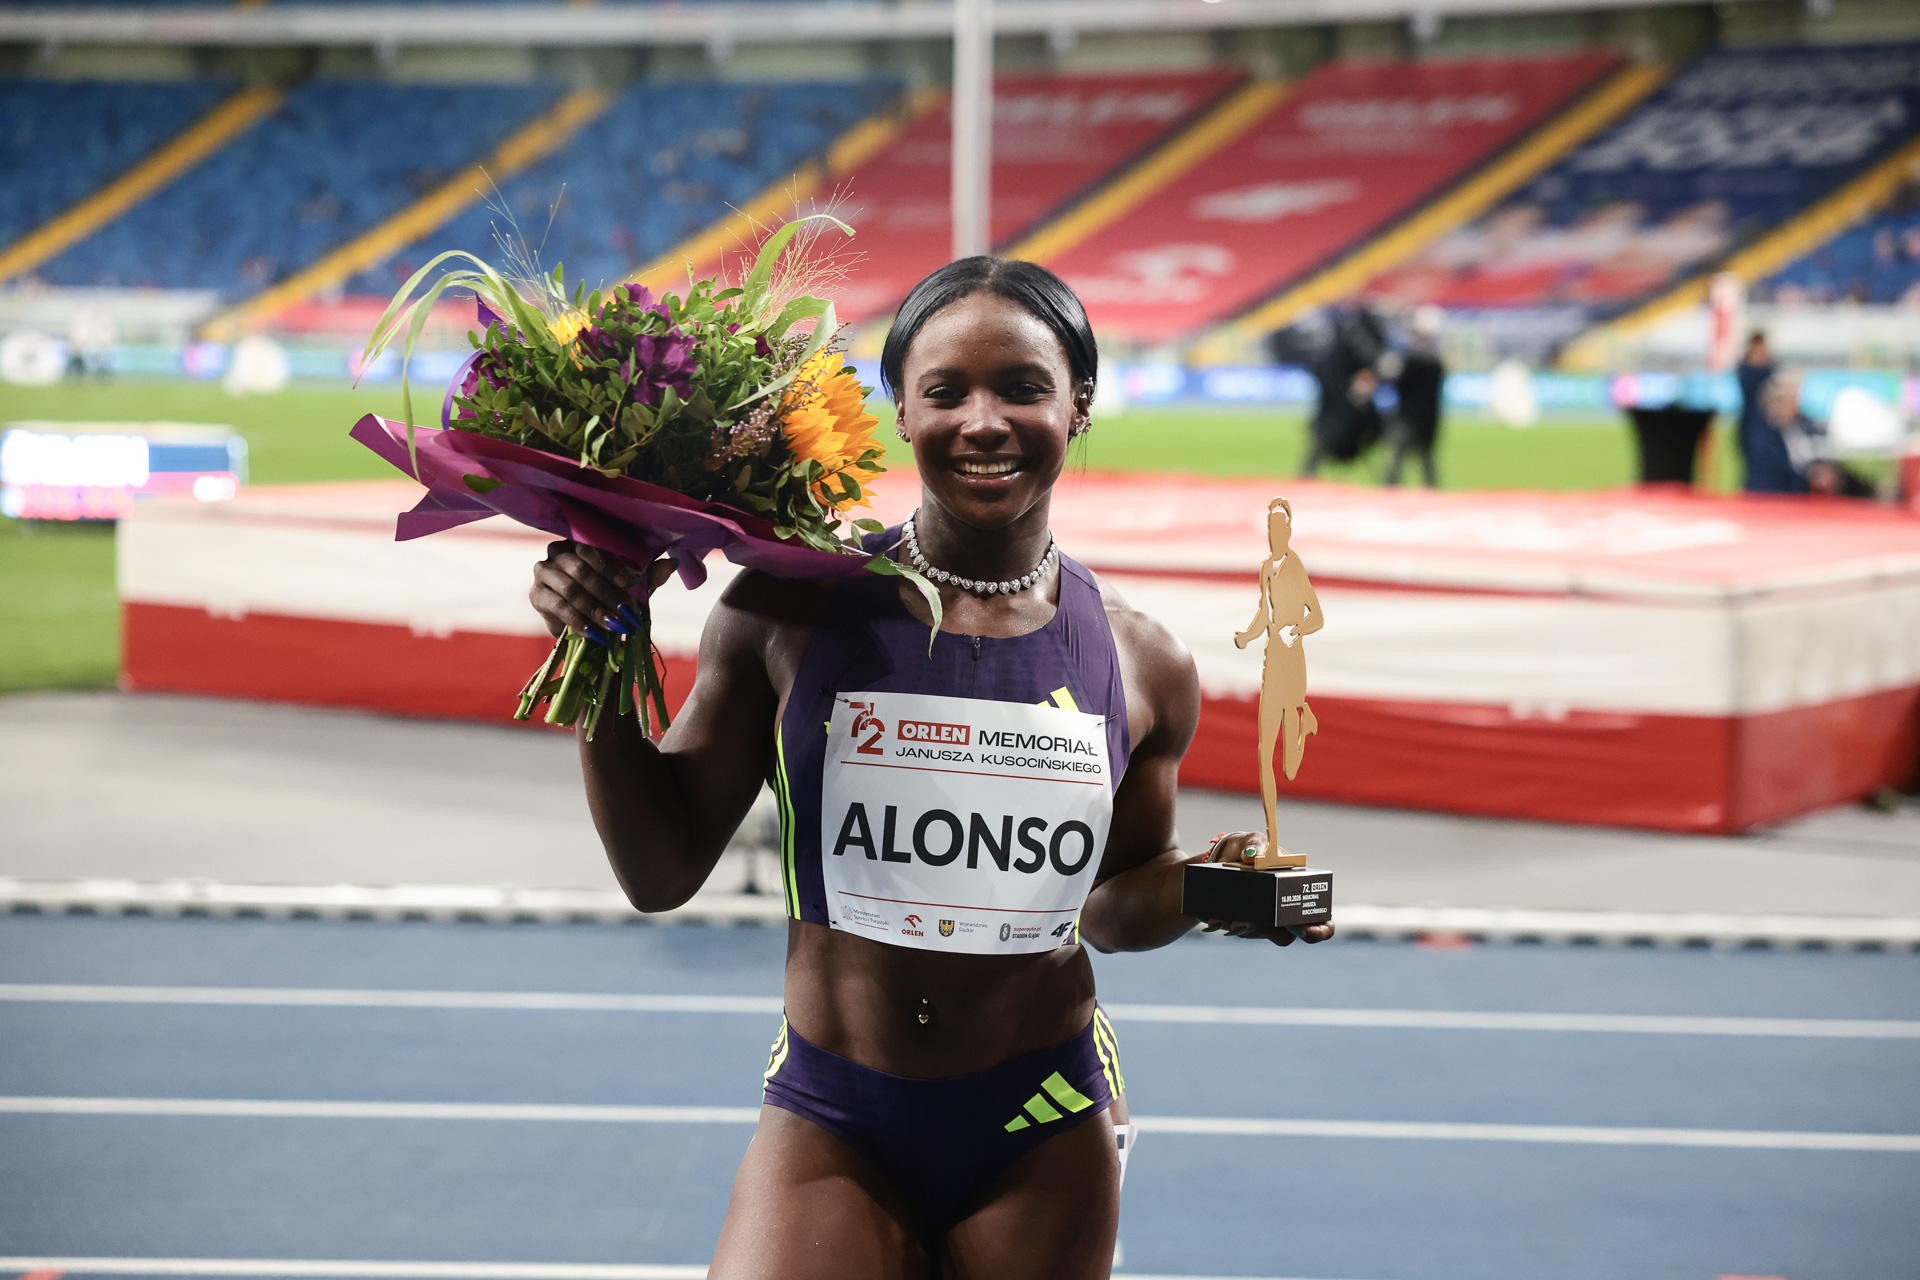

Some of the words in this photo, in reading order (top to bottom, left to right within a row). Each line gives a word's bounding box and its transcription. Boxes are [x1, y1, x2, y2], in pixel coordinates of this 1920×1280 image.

[901, 723, 967, 743] ORLEN
[978, 730, 1098, 756] MEMORIAŁ
[895, 747, 974, 763] JANUSZA
[981, 753, 1102, 774] KUSOCIŃSKIEGO
[832, 802, 1095, 876] ALONSO
[1312, 883, 1327, 891] ORLEN
[901, 929, 924, 937] ORLEN
[1050, 921, 1073, 938] 4F
